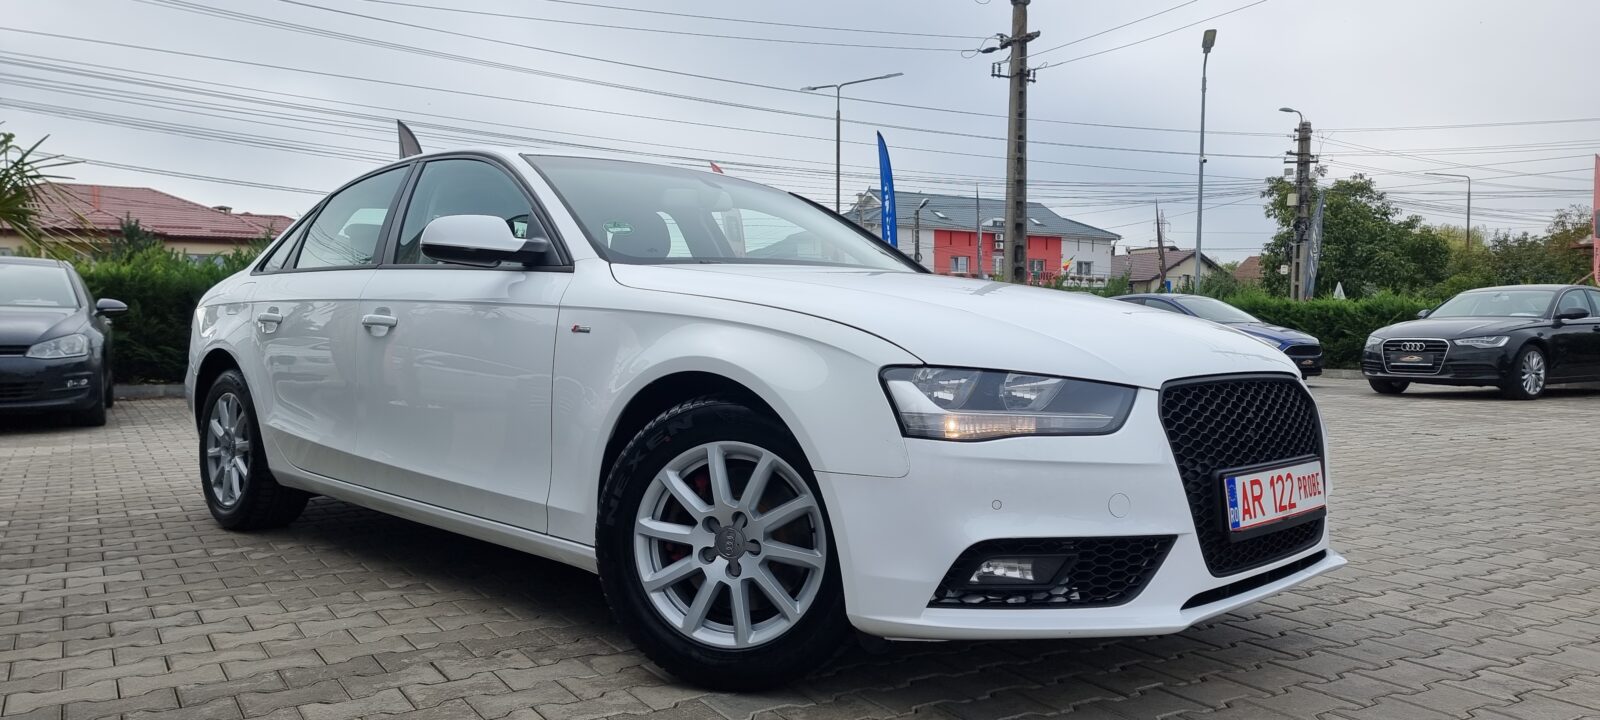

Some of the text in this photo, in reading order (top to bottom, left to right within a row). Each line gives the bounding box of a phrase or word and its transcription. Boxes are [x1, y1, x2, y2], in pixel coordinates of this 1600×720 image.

[606, 415, 694, 526] NEXEN
[1230, 507, 1239, 521] RO
[1242, 472, 1321, 521] AR 122 PROBE
